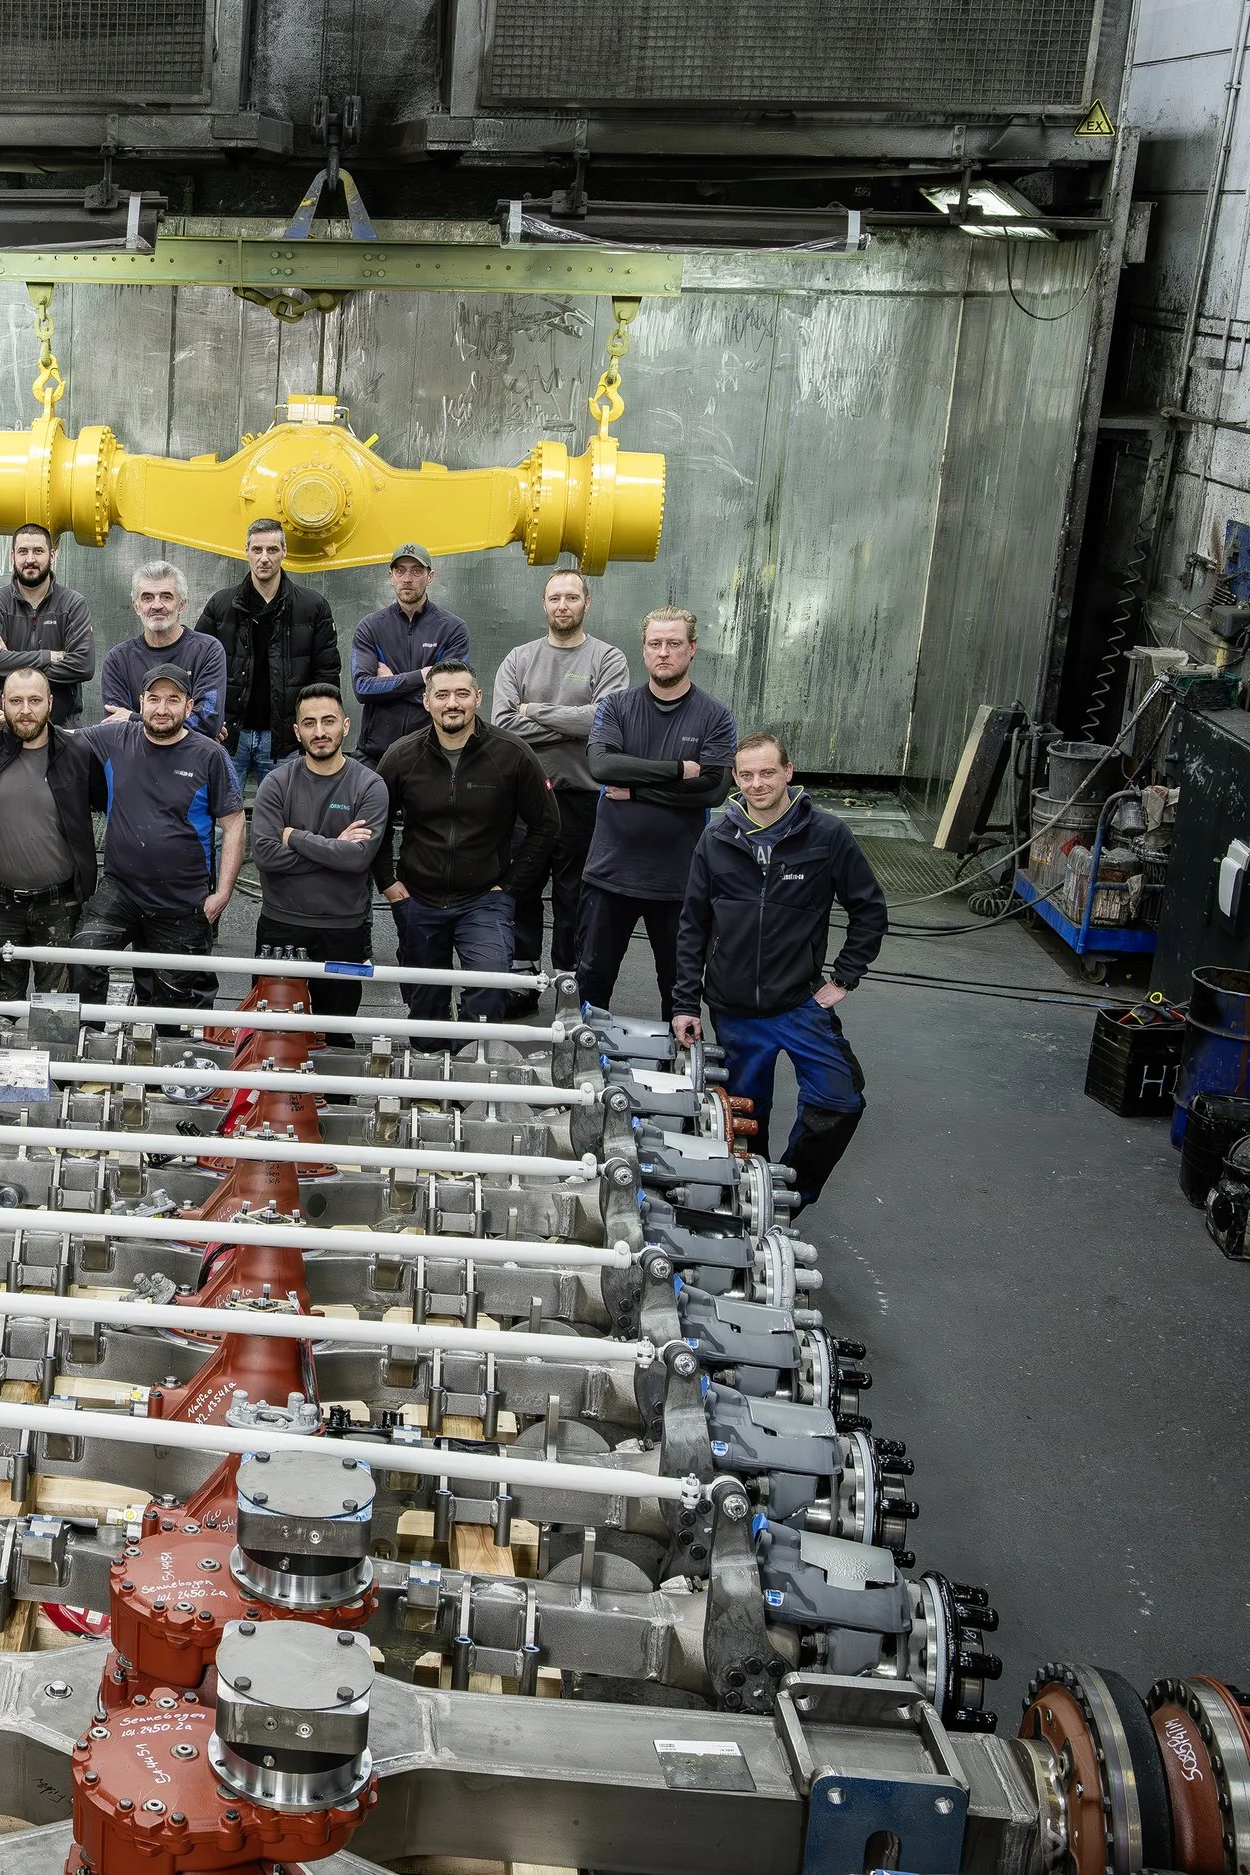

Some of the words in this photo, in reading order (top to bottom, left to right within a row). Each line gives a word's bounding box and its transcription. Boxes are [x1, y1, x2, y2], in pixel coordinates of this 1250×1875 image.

[1087, 121, 1104, 132] EX
[187, 1389, 213, 1418] Naffco
[141, 1579, 214, 1594] Sennebogen
[119, 1712, 206, 1726] Sennebogen
